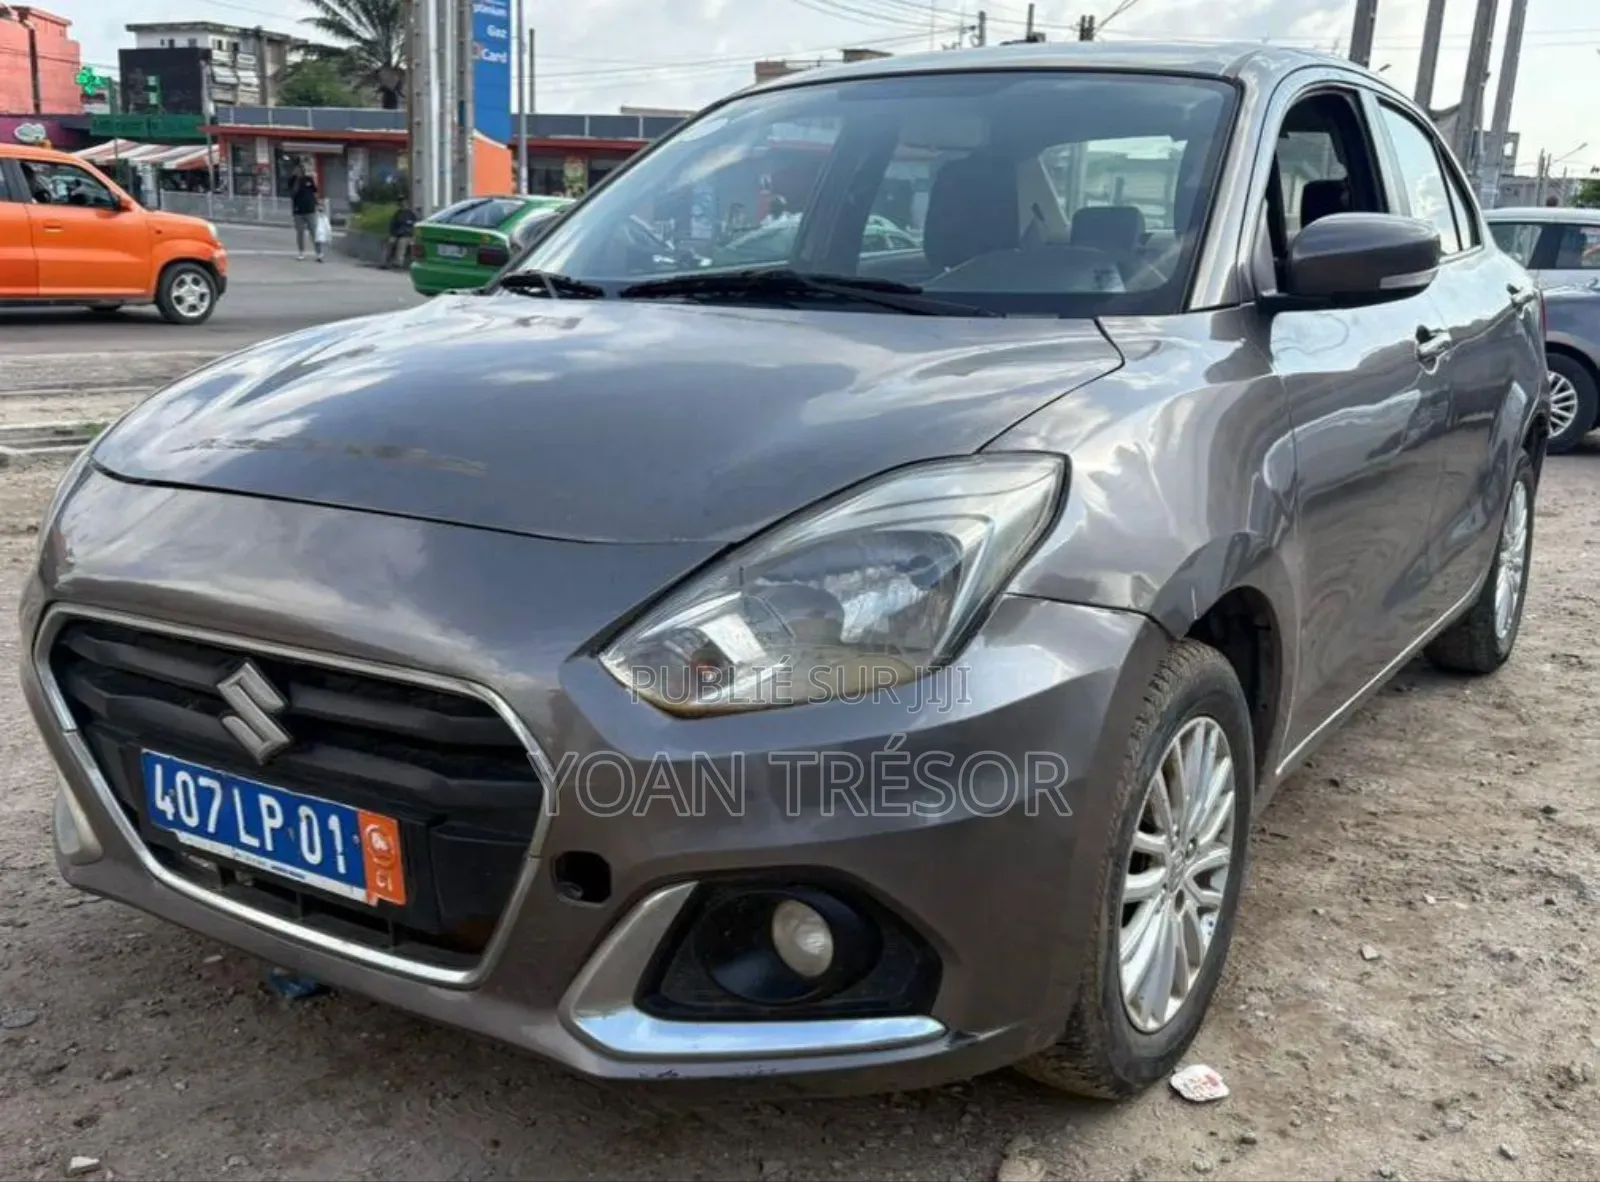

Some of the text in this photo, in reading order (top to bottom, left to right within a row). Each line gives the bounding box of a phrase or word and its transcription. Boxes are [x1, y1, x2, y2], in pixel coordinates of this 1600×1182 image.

[155, 764, 222, 833] 407
[233, 787, 283, 851] LP
[298, 805, 346, 874] 01
